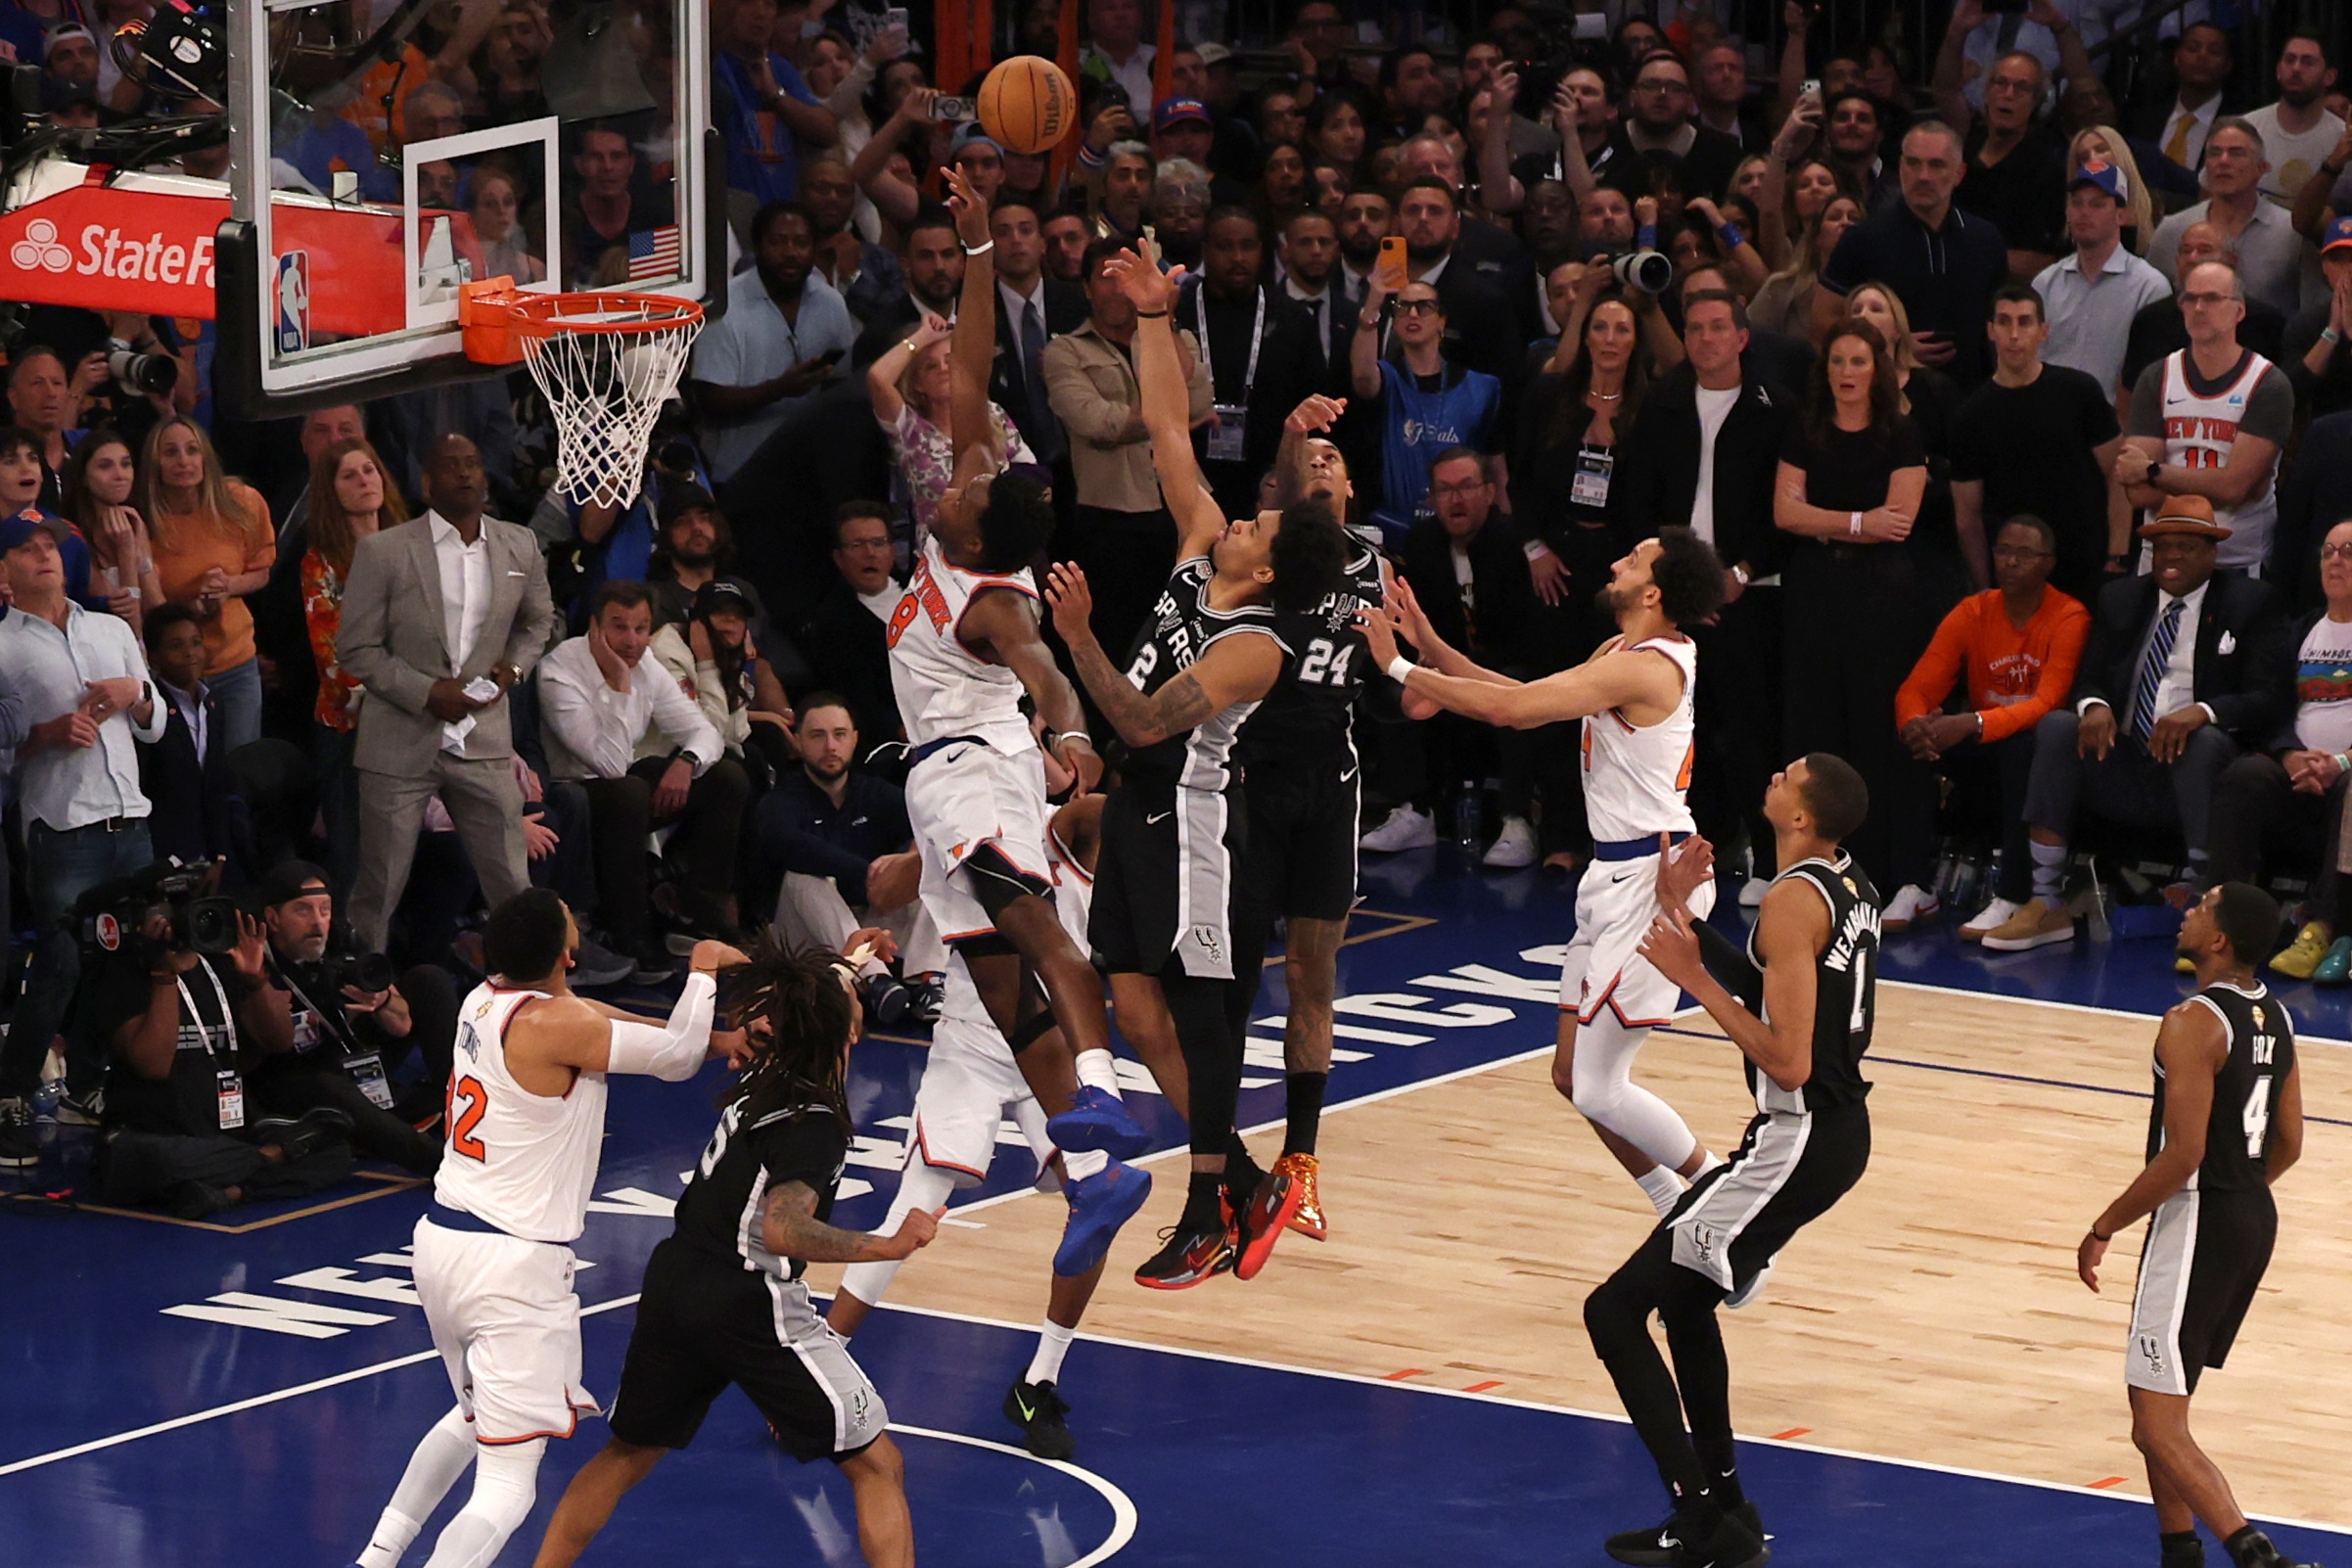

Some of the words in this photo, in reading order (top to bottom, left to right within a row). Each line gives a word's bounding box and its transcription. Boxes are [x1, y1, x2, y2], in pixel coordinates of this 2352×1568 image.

[886, 591, 919, 651] 8
[1127, 641, 1158, 691] 2
[1298, 637, 1356, 687] 24
[1849, 946, 1868, 1034] 1
[2252, 1035, 2277, 1066] FOX
[2242, 1075, 2274, 1159] 4
